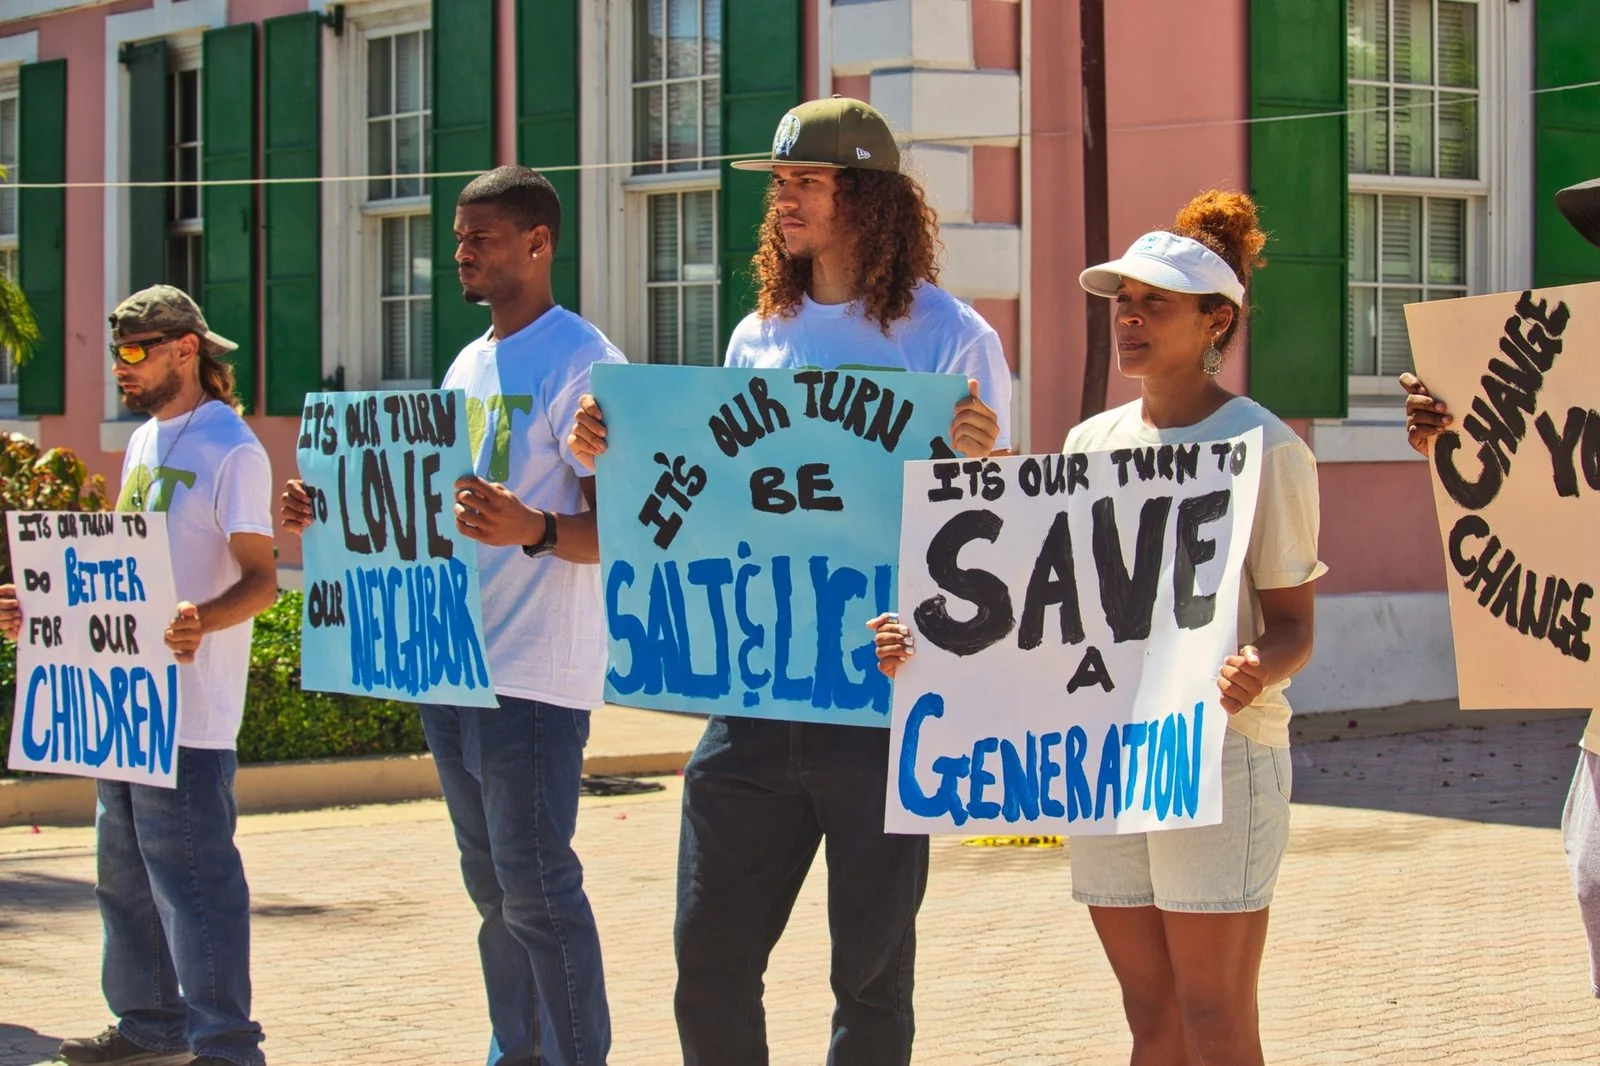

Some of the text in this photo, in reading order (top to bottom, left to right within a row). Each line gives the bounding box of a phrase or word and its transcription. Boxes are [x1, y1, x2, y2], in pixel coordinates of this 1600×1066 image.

[345, 396, 380, 448] OUR
[384, 391, 456, 448] TURN
[1434, 290, 1570, 510] CHANGE
[638, 371, 914, 549] IT'S OUR TURN
[750, 463, 844, 514] BE
[928, 441, 1247, 502] IT'S OUR TURN TO
[57, 513, 78, 539] OUR
[79, 513, 114, 537] TURN
[121, 514, 147, 539] TO
[304, 485, 328, 524] TO
[338, 448, 454, 561] LOVE
[24, 547, 146, 606] DO BETTER
[913, 489, 1231, 657] SAVE
[1449, 514, 1594, 662] CHANGE
[29, 614, 139, 655] FOR OUR
[308, 557, 489, 696] OUR NEIGHBOR
[1066, 646, 1115, 694] A
[22, 664, 177, 775] CHILDREN
[898, 692, 1204, 826] GENERATION
